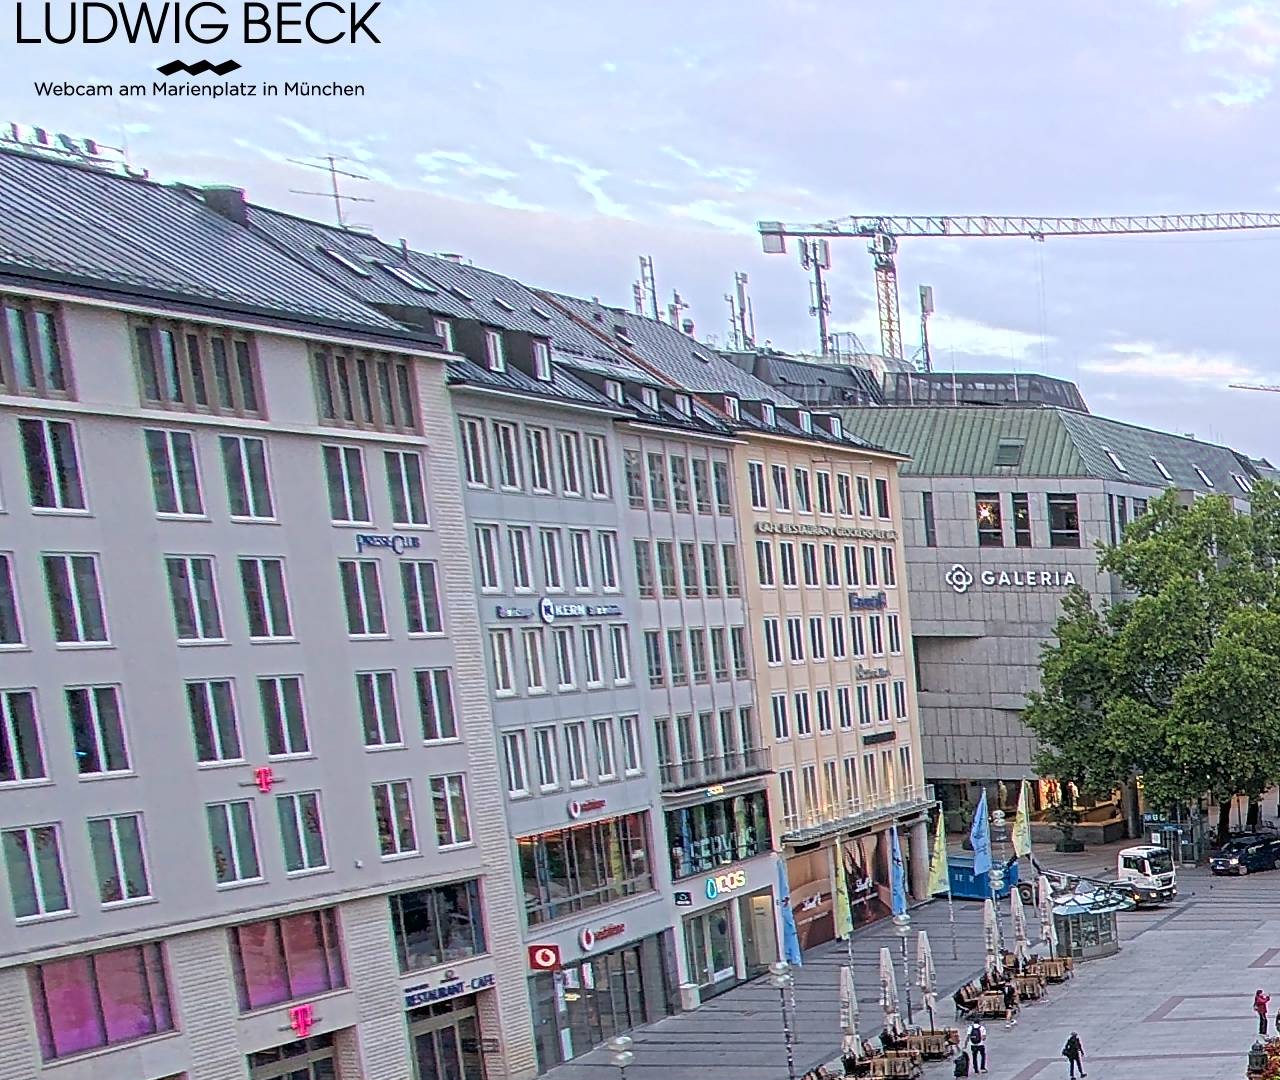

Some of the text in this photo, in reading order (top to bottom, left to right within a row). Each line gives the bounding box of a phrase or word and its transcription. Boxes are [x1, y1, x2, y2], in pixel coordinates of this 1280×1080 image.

[981, 570, 1077, 586] GALERIA
[554, 603, 586, 617] KERN
[716, 870, 746, 894] IQOS
[290, 1005, 313, 1036] T
